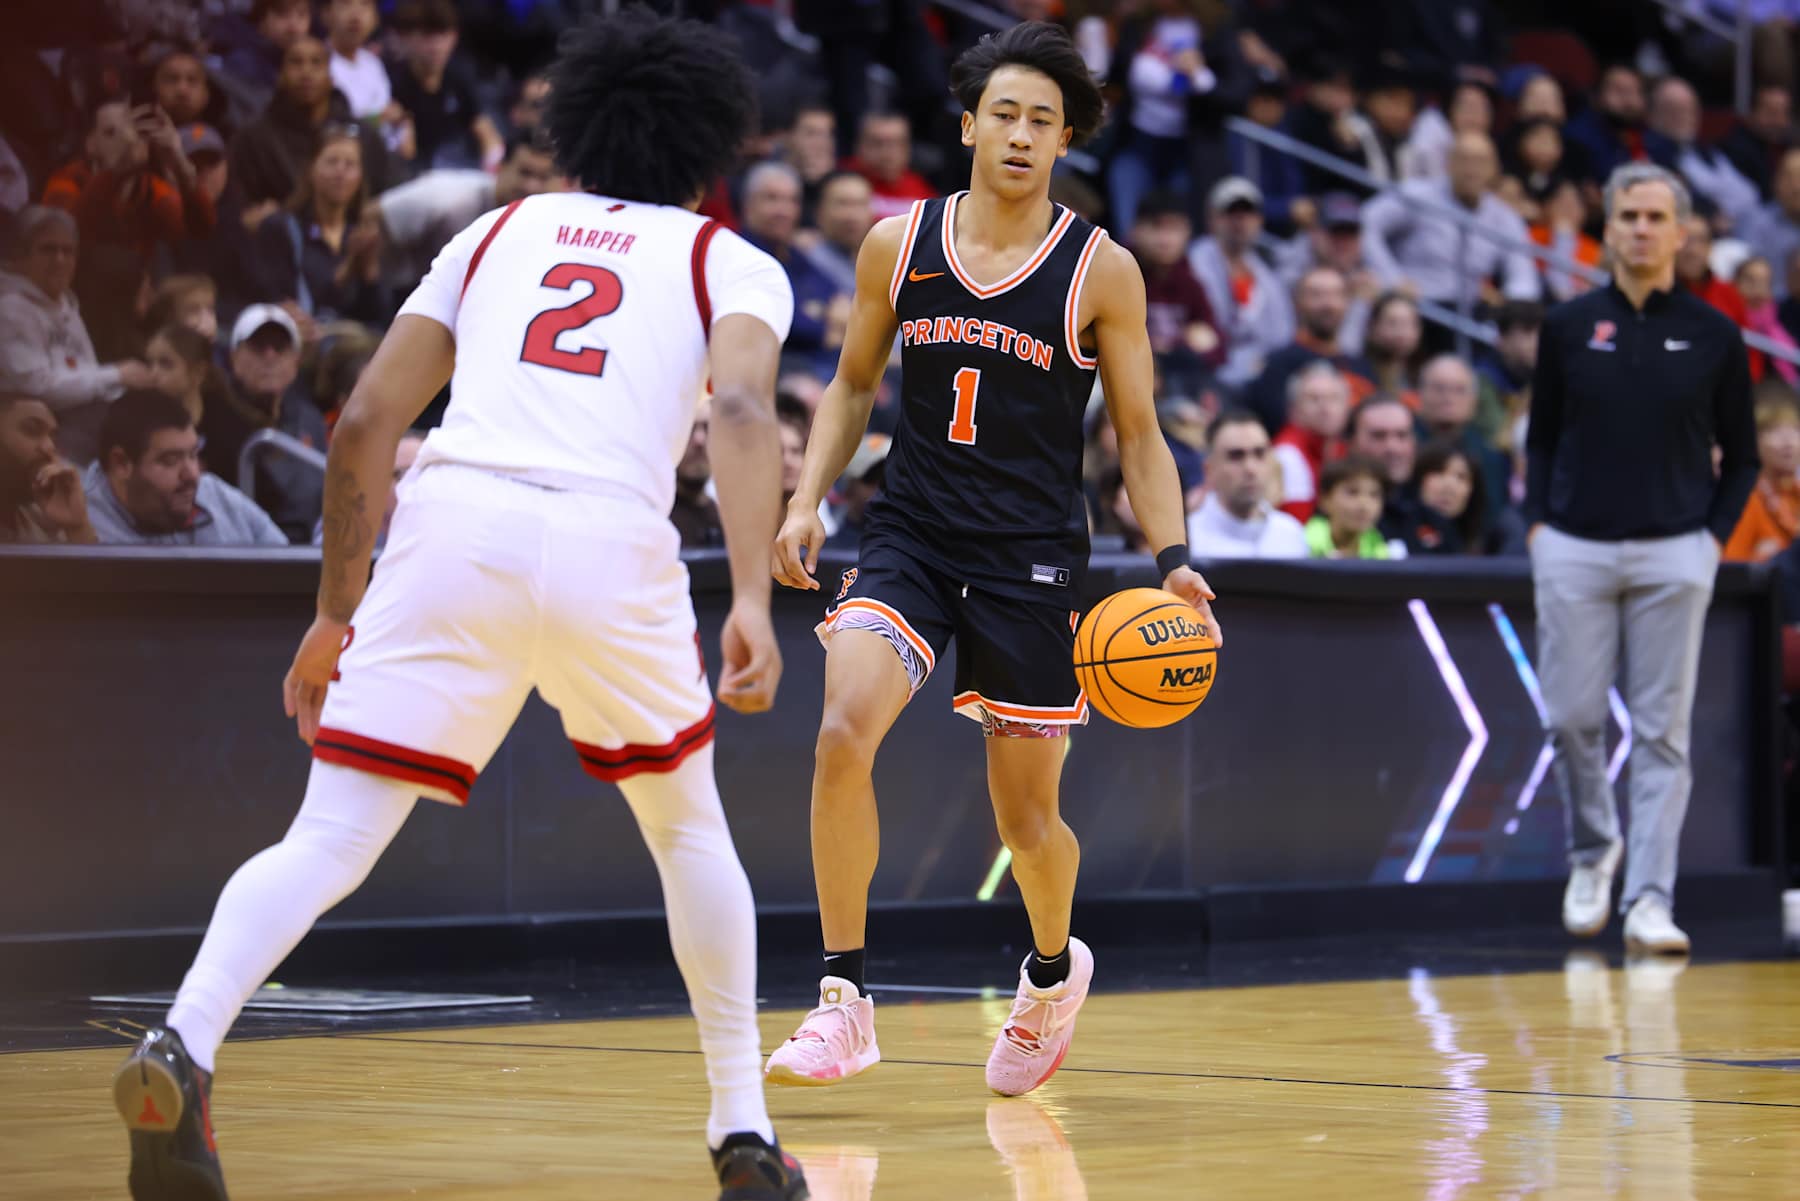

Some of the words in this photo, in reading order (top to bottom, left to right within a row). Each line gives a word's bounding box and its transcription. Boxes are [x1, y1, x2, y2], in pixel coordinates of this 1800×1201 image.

[556, 225, 637, 255] HARPER
[519, 262, 624, 377] 2
[902, 315, 1054, 372] PRINCETON
[947, 366, 982, 446] 1
[1058, 572, 1065, 582] L
[1137, 616, 1209, 646] Wilso
[1160, 663, 1212, 687] NCAA
